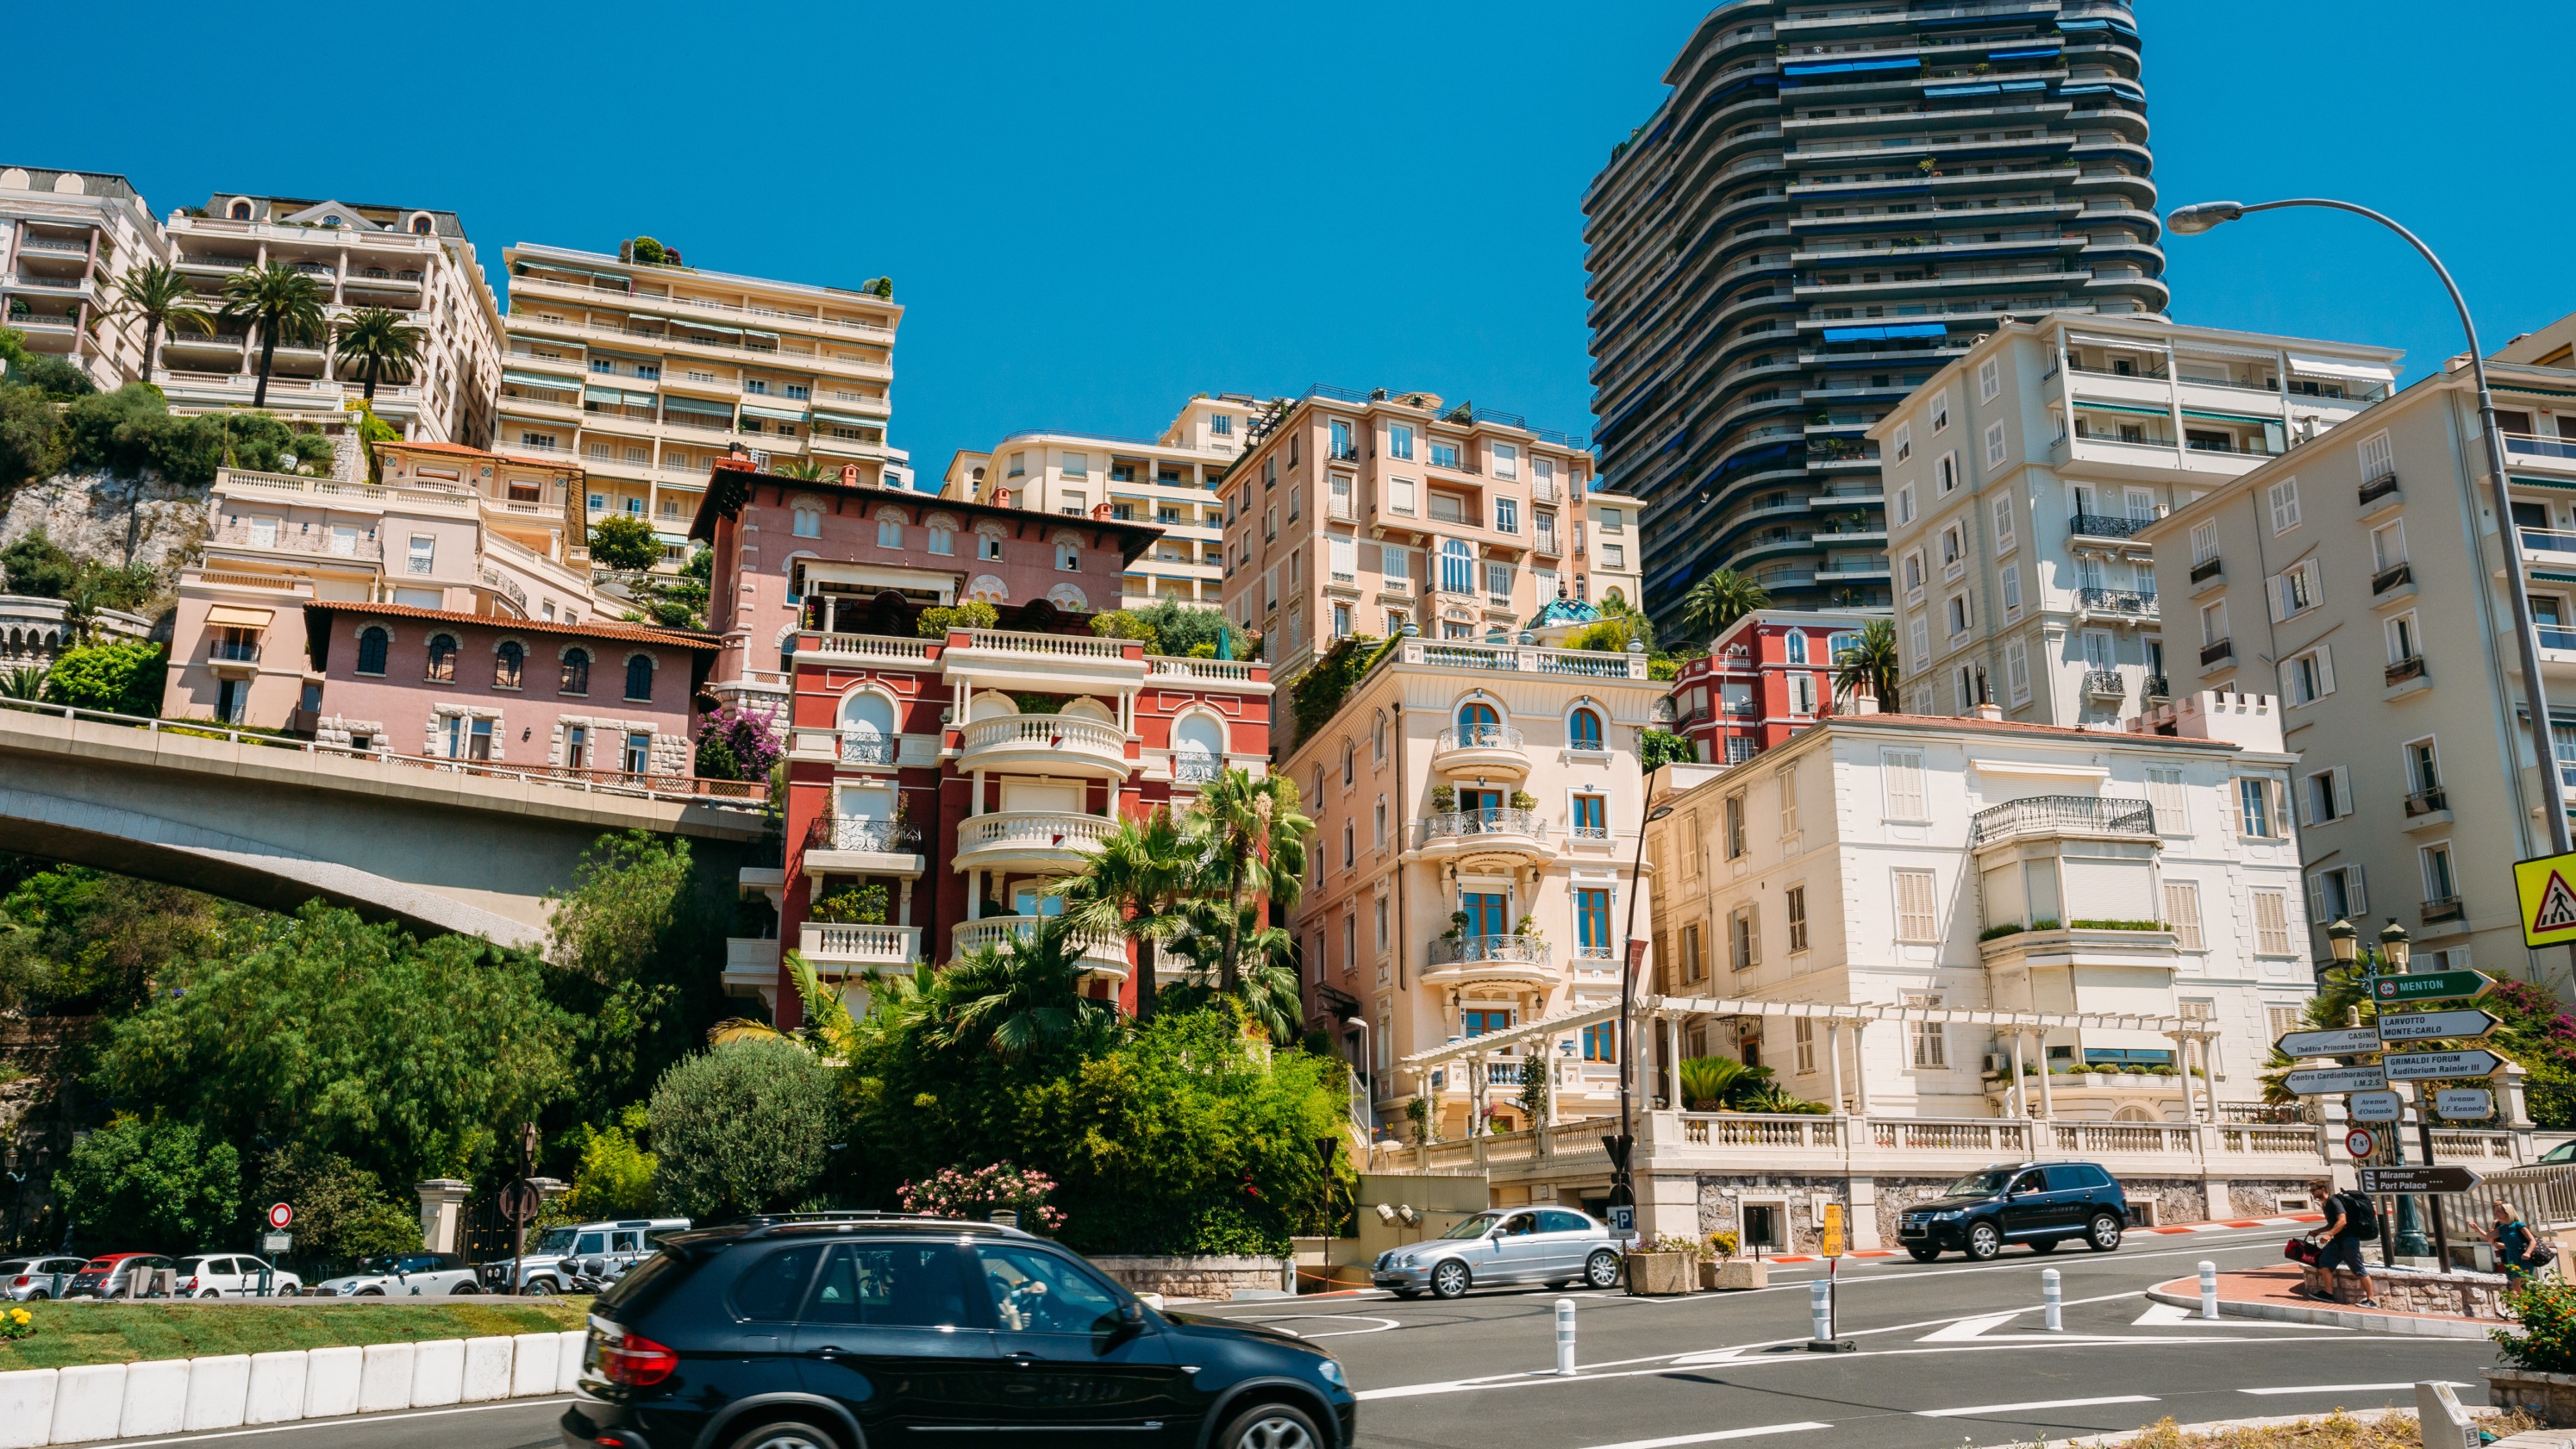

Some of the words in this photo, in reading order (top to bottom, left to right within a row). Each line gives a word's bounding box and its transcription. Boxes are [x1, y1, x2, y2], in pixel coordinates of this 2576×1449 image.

[2399, 979, 2444, 992] MENTON
[2385, 1016, 2425, 1026] LARVOTTO
[2348, 1031, 2376, 1040] CASINO
[2384, 1026, 2442, 1036] MONTE-CARLO
[2323, 1041, 2356, 1052] Princesse
[2390, 1056, 2429, 1065] GRIMALDI
[2431, 1054, 2460, 1064] FORUM
[2392, 1067, 2436, 1076] Auditorium
[2439, 1065, 2469, 1073] Rainier
[2291, 1073, 2315, 1082] Centre
[2317, 1070, 2382, 1080] Cardiothoracique
[2357, 1107, 2393, 1115] d'Ostende
[2379, 1171, 2415, 1179] Miramar
[2398, 1181, 2427, 1190] Palace
[1619, 1211, 1629, 1227] P
